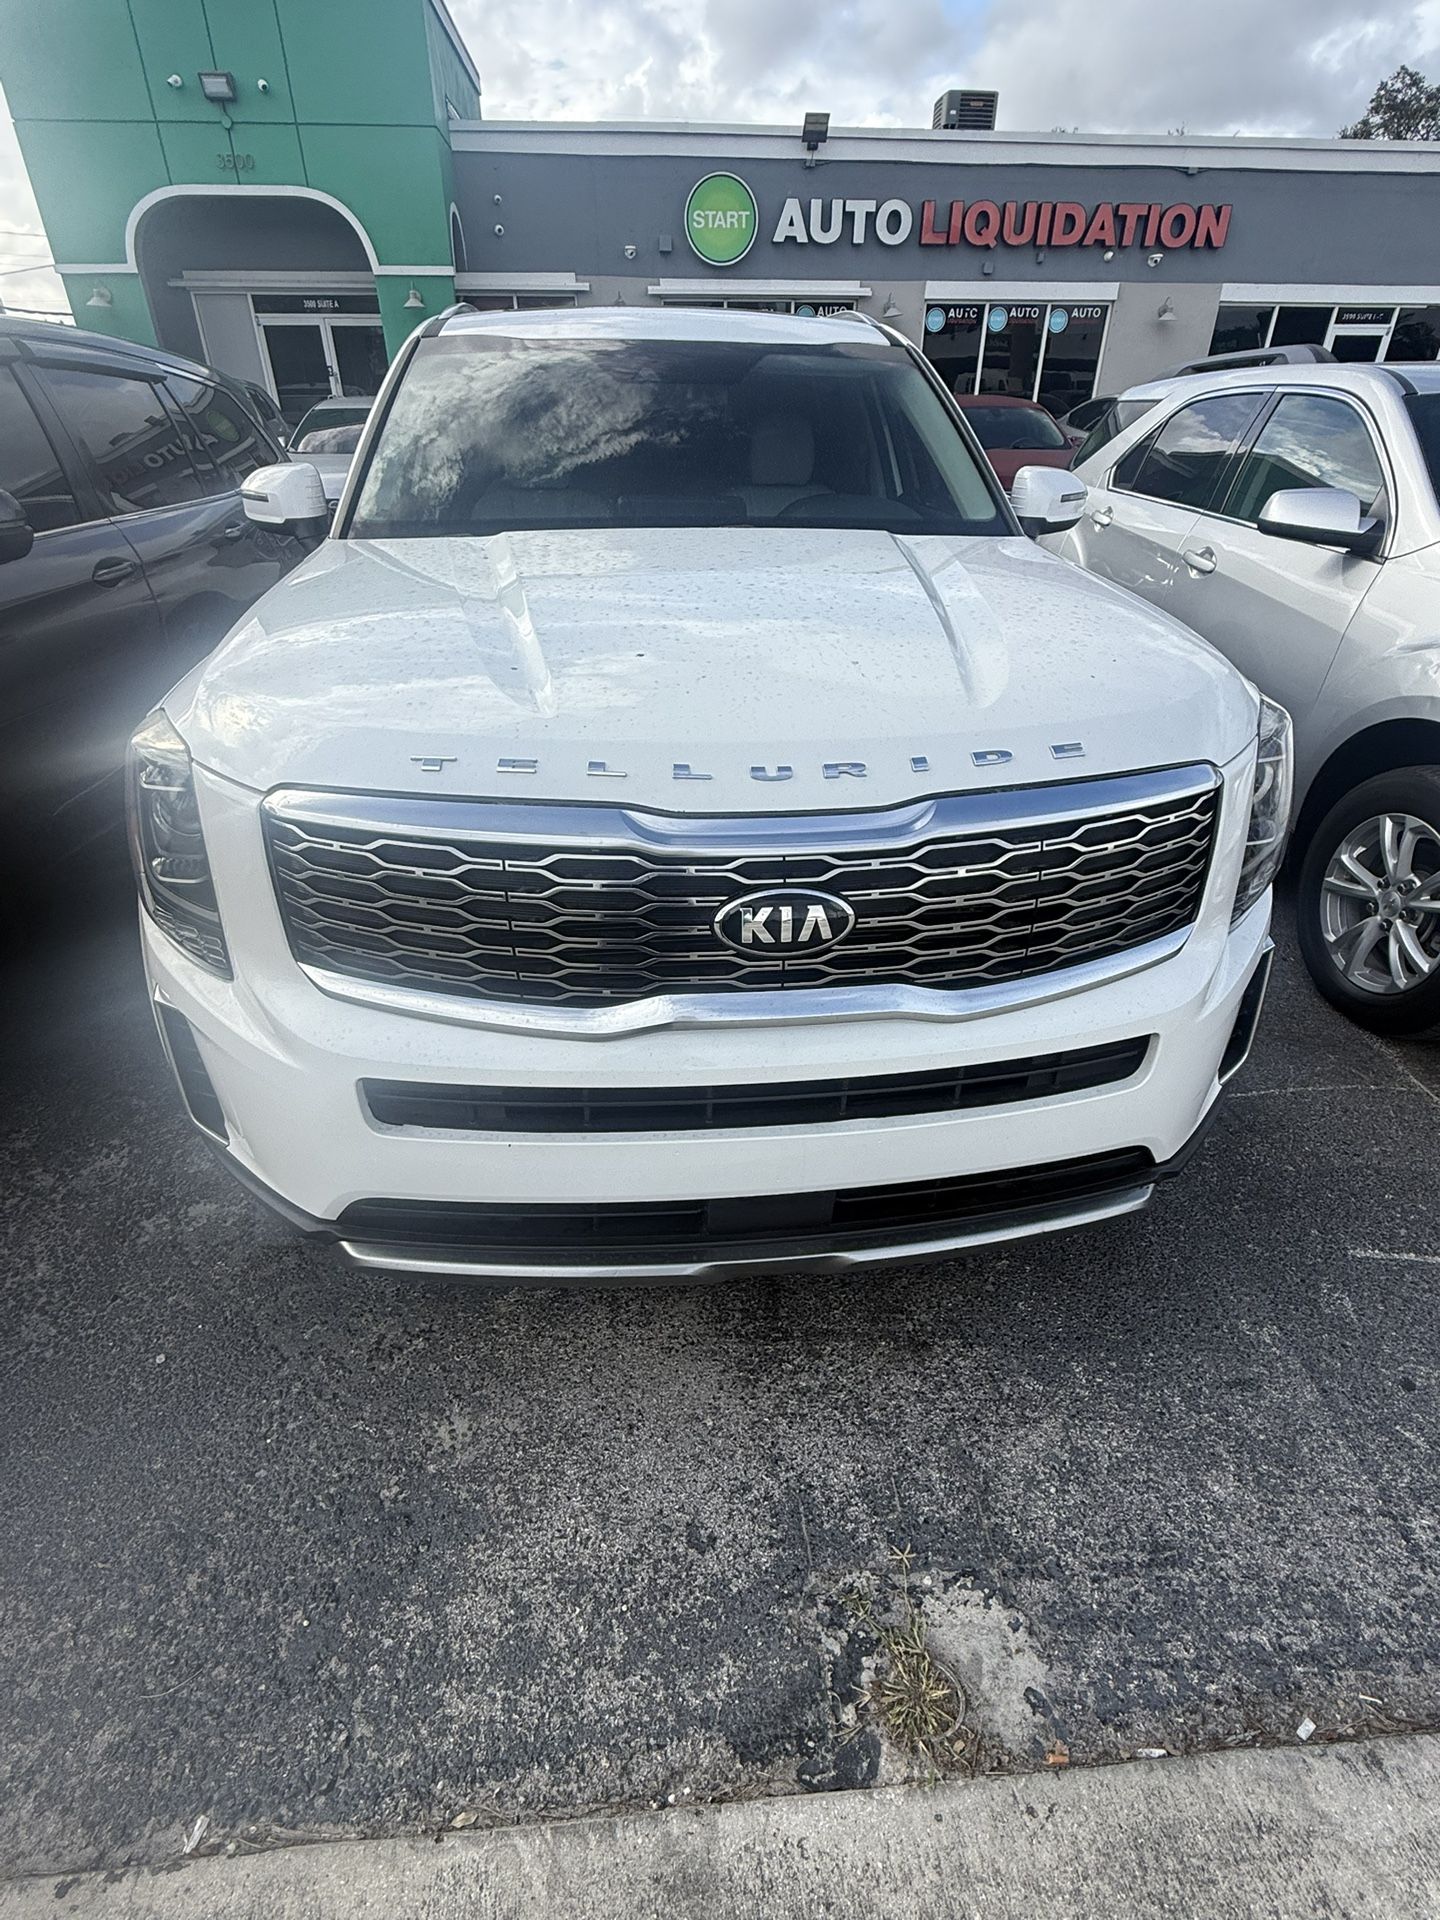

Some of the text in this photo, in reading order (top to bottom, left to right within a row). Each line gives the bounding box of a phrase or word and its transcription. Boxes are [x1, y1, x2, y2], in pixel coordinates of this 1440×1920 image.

[216, 152, 256, 170] 3500
[693, 210, 750, 229] START
[772, 198, 1233, 249] AUTO LIQUIDATION
[1009, 307, 1040, 319] AUTO
[1071, 307, 1101, 319] AUTO
[410, 742, 1086, 781] TELLURIDE
[739, 904, 833, 944] KIA
